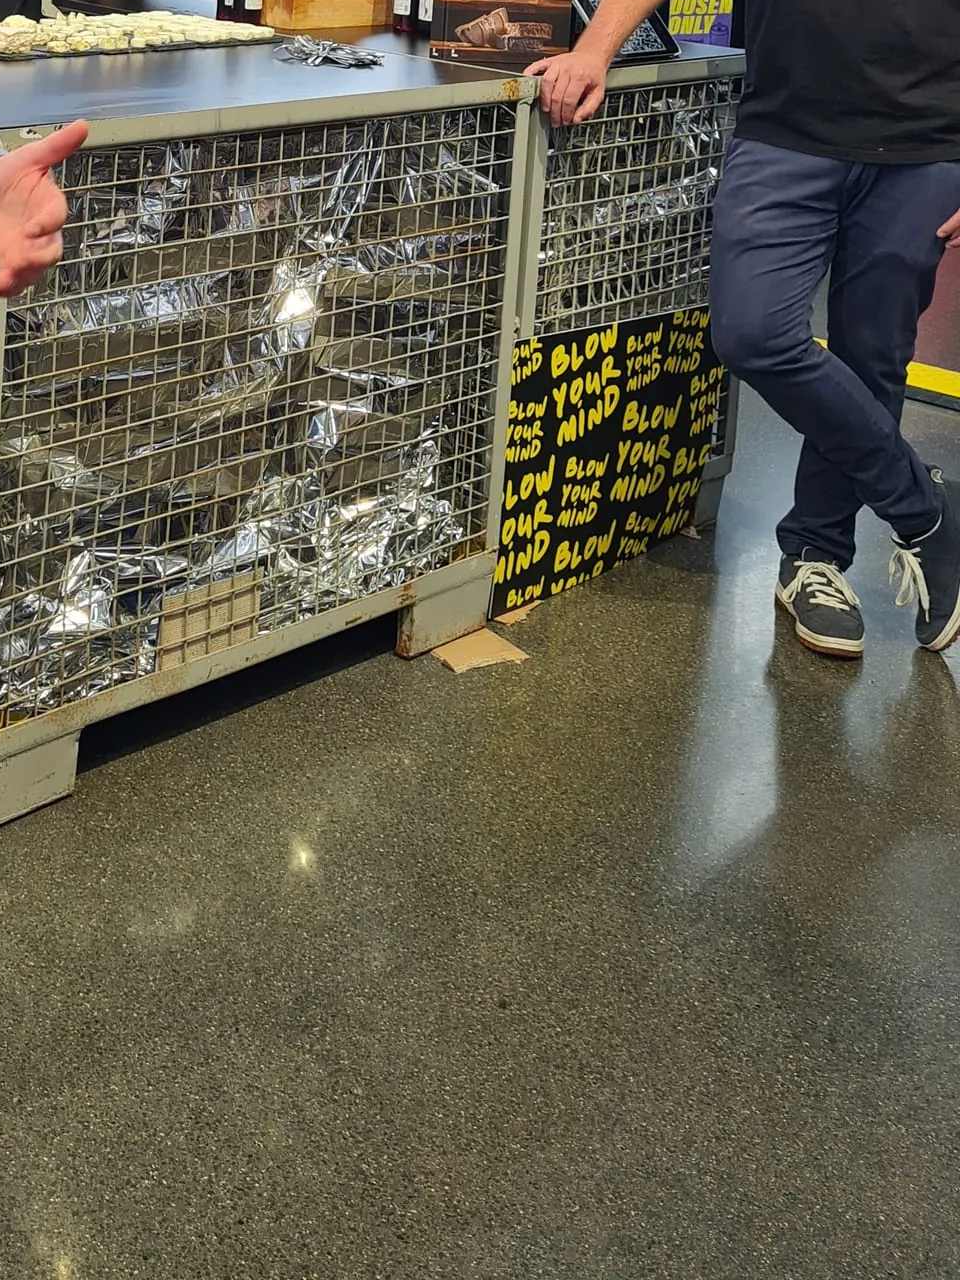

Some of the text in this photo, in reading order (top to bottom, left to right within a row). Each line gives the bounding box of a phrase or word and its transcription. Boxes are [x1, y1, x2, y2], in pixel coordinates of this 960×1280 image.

[669, 15, 717, 36] ONLY
[673, 310, 711, 328] BLOW
[551, 322, 619, 379] BLOW
[626, 322, 664, 354] BLOW
[668, 331, 704, 353] YOUR
[626, 346, 662, 377] YOUR
[663, 351, 701, 374] MIND
[552, 355, 622, 419] YOUR
[626, 363, 661, 393] MIND
[507, 395, 548, 420] BLOW
[556, 384, 620, 448] MIND
[622, 394, 683, 434] BLOW
[506, 420, 544, 446] YOUR
[504, 438, 542, 463] MIND
[616, 434, 672, 473] YOUR
[565, 453, 610, 480] BLOW
[501, 454, 555, 511] LOW
[561, 480, 602, 508] YOUR
[609, 463, 666, 502] MIND
[556, 501, 598, 528] MIND
[624, 512, 662, 534] BLOW
[553, 518, 617, 573] BLOW
[616, 536, 649, 558] YOUR
[506, 575, 545, 609] BLOW
